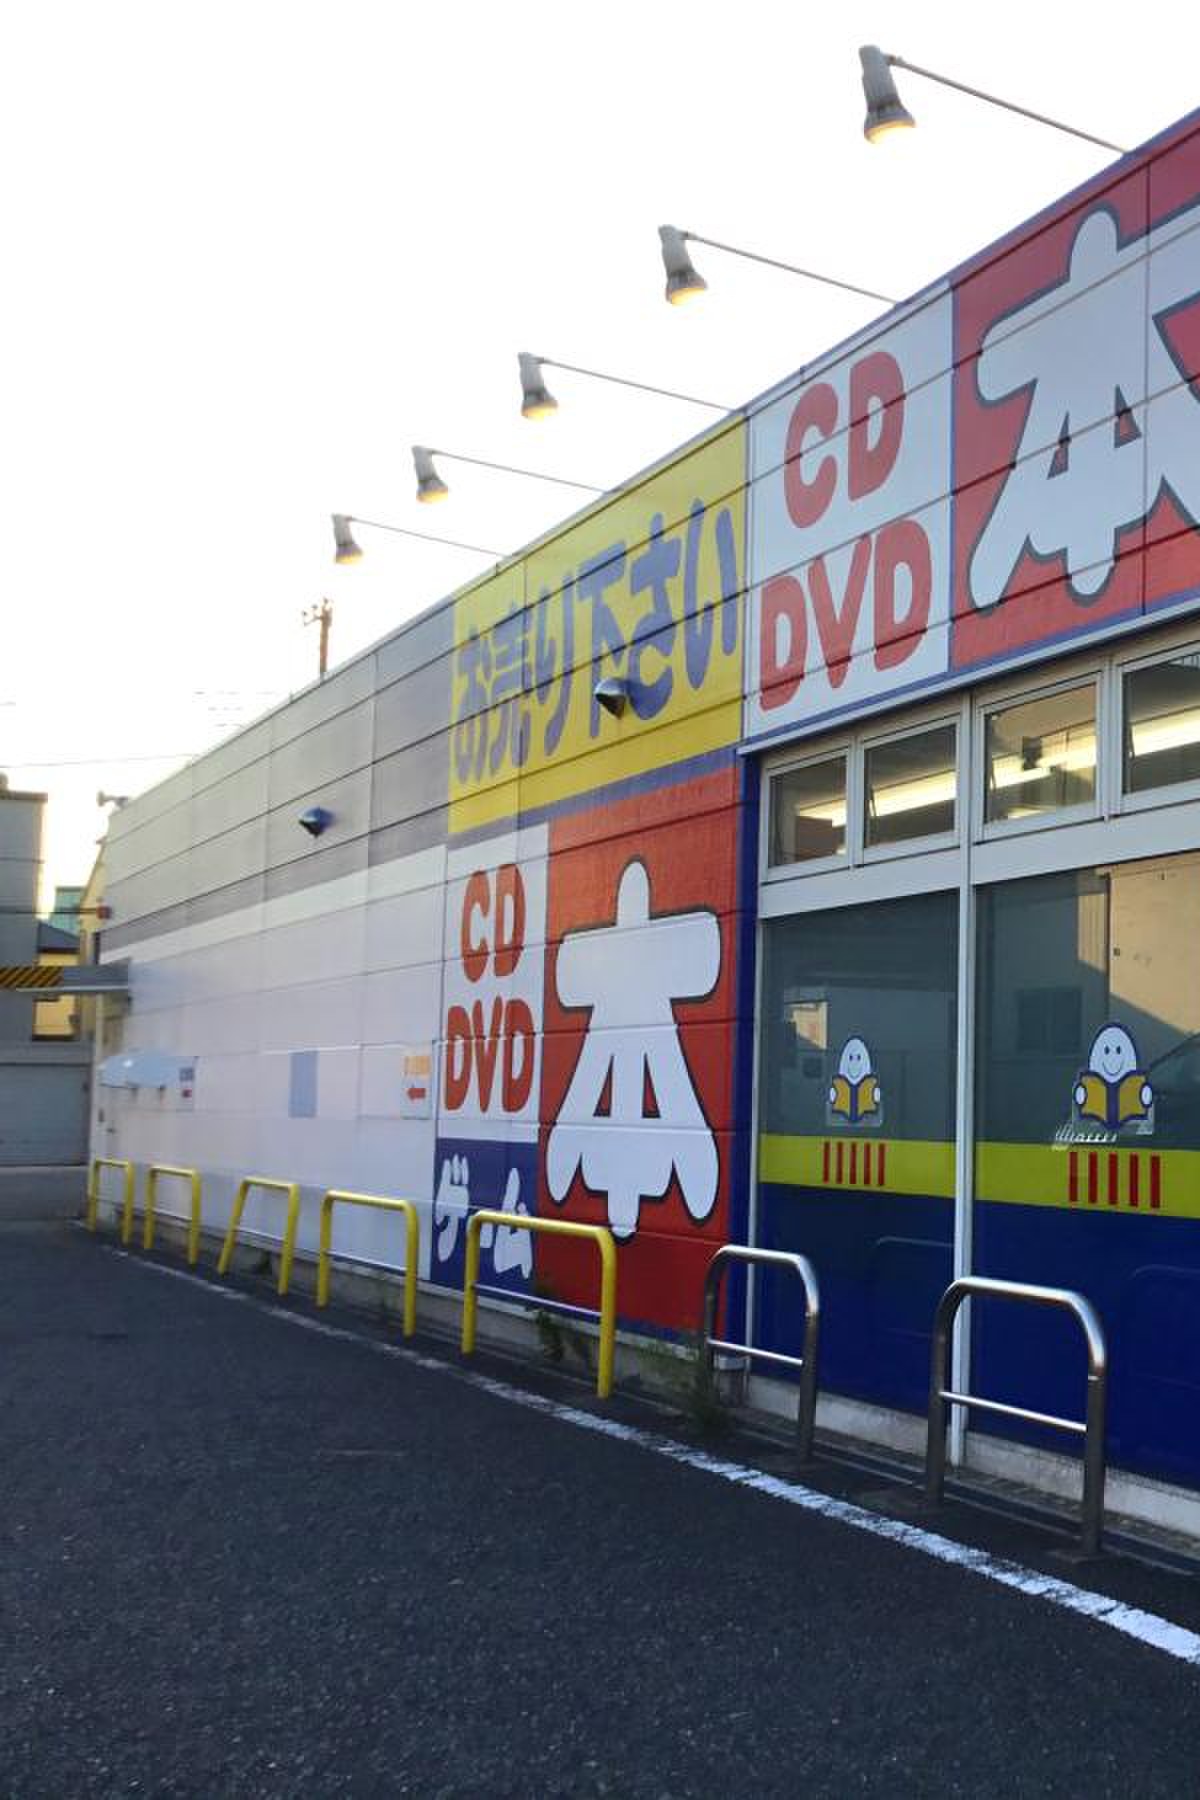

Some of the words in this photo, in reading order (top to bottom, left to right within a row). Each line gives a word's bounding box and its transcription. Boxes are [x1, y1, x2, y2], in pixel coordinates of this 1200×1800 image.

[783, 351, 905, 529] CD
[453, 498, 738, 785] お売り下さい
[760, 520, 932, 711] DVD
[462, 863, 525, 982] CD
[444, 997, 535, 1113] DVD
[547, 855, 721, 1244] 本
